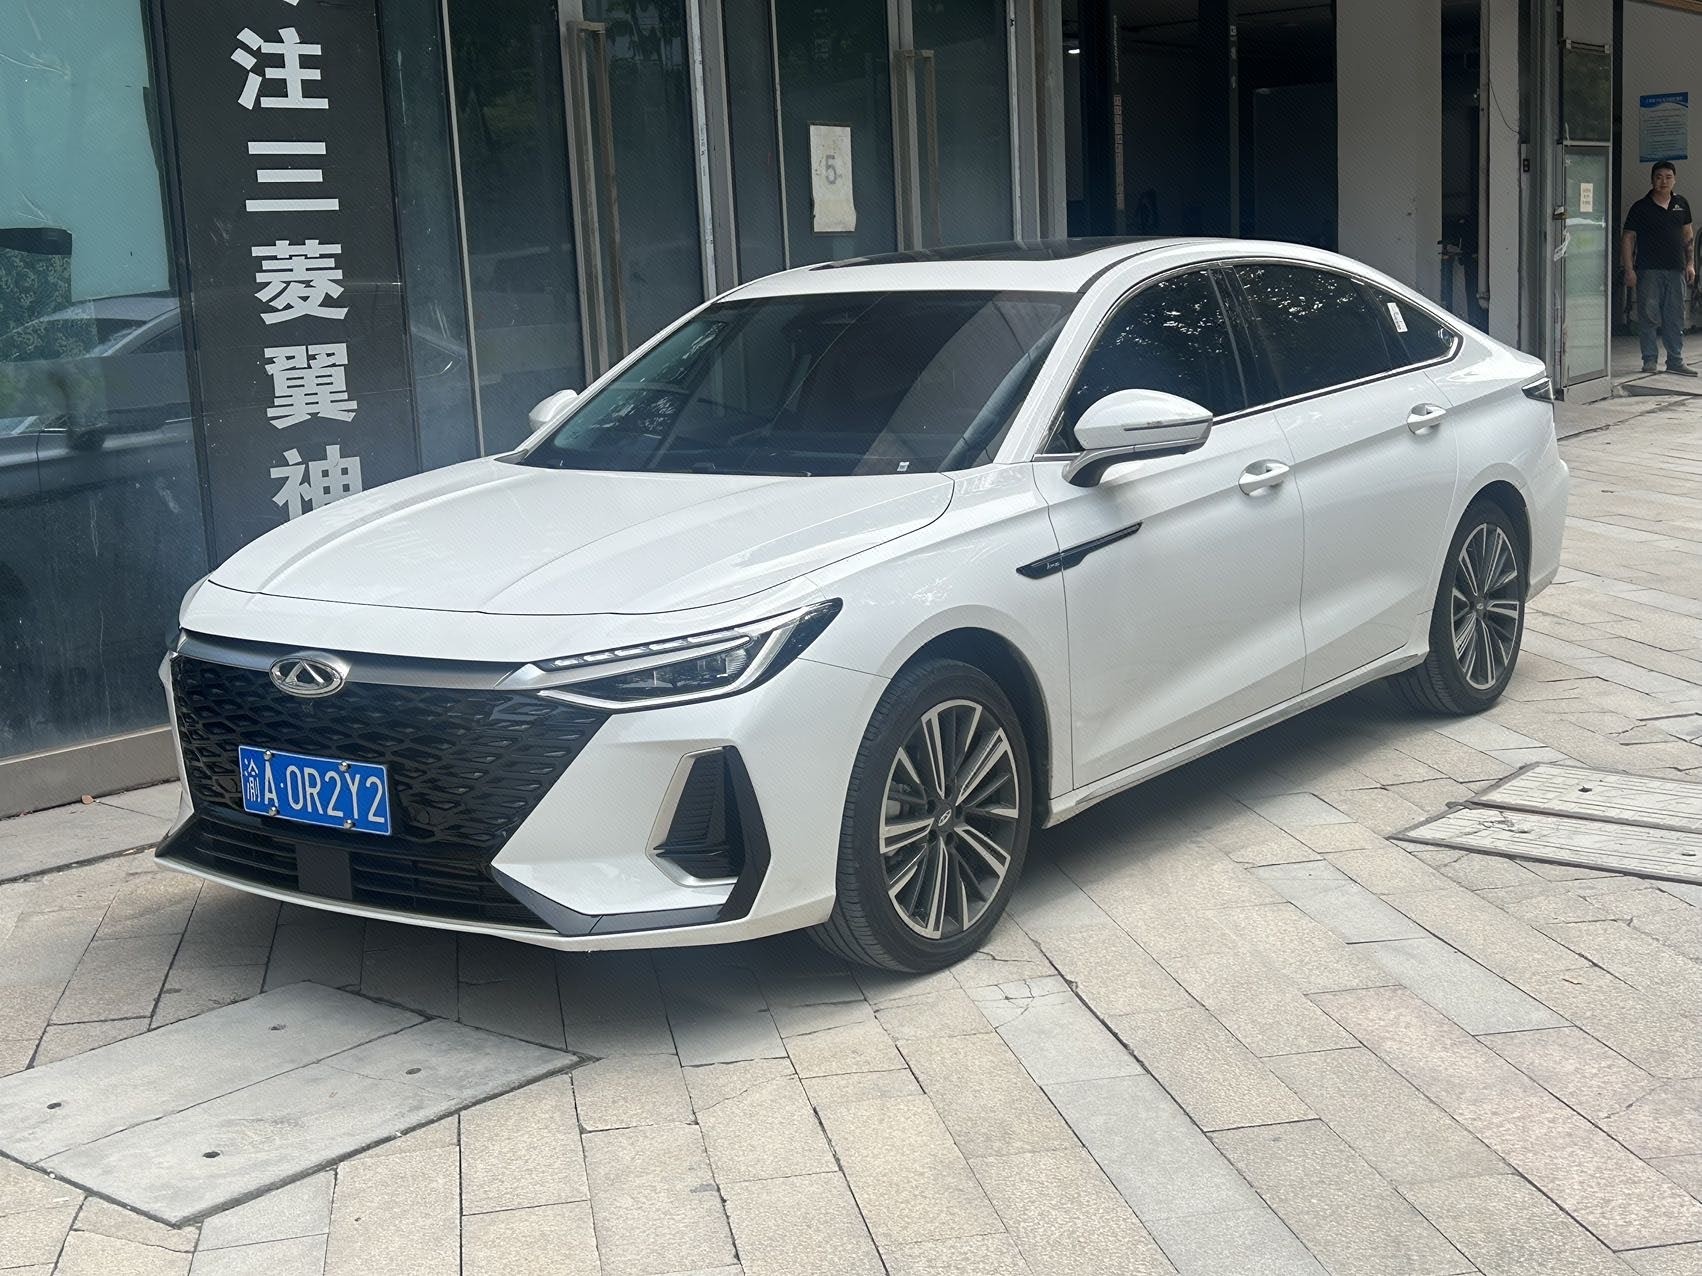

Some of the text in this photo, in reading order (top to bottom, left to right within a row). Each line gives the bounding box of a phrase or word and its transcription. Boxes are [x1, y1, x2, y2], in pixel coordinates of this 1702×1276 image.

[231, 0, 363, 521] 注三菱翼神
